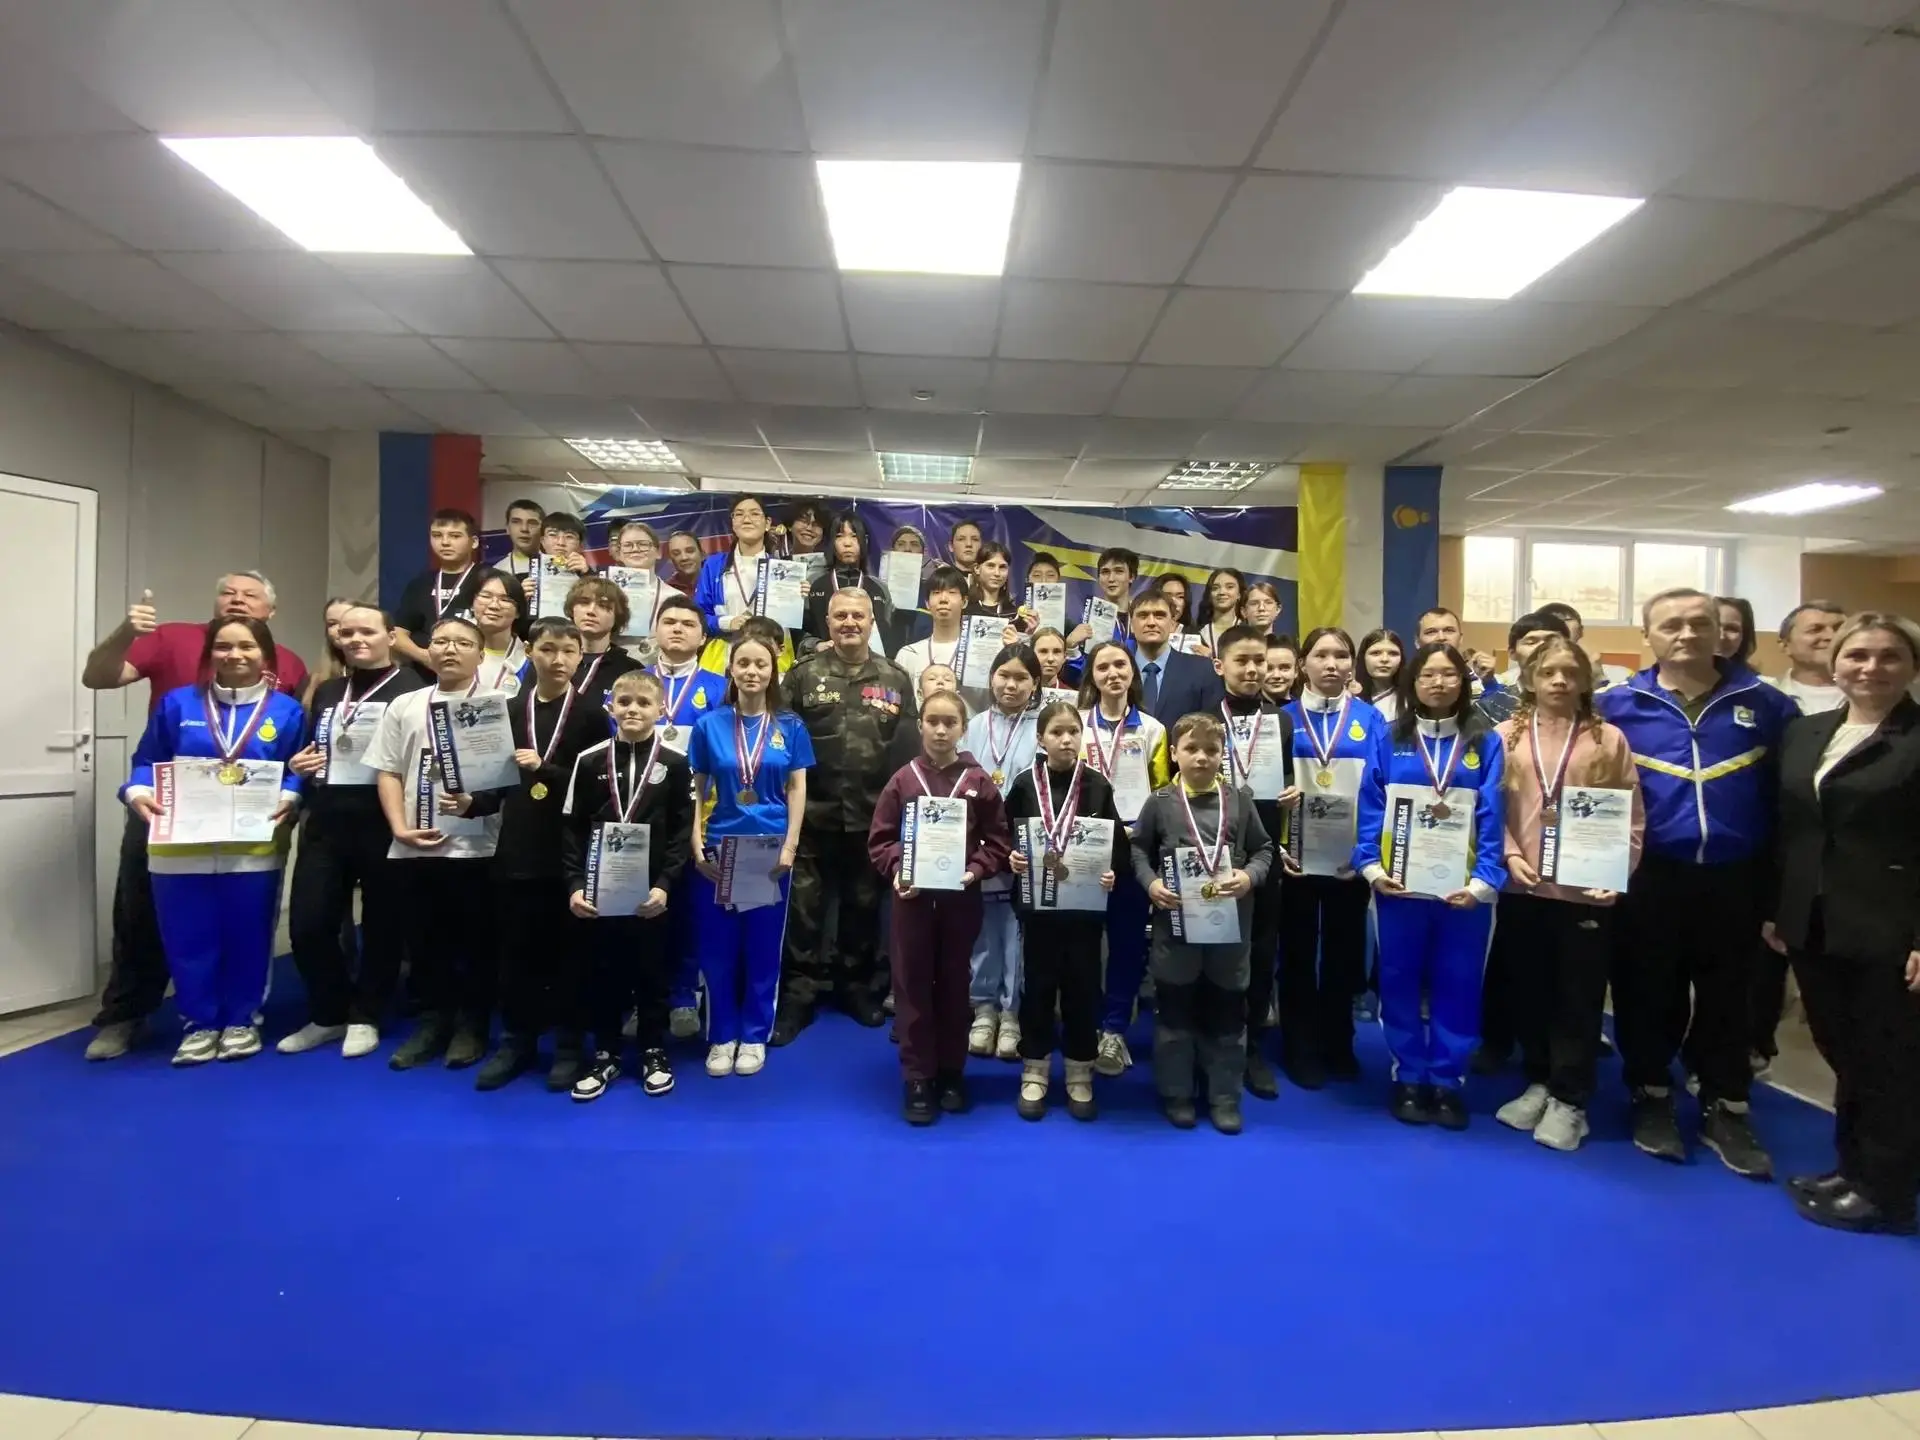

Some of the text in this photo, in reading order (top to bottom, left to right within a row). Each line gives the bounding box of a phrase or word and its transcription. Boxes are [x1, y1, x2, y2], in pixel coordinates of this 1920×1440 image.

[755, 562, 767, 616] УЛЕВАЯ СТРЕЛЬБА
[959, 620, 969, 652] СТРЕЛЬБА
[319, 707, 334, 743] СТРЕЛЬБА
[434, 707, 459, 789] ПУЛЕВАЯ СТРЕЛЬБА
[161, 766, 174, 806] СТРЕЛЬБА
[902, 801, 916, 880] ПУЛЕВАЯ СТРЕЛЬБА
[1395, 804, 1409, 844] СТРЕЛЬБА
[588, 828, 601, 871] СТРЕЛЬБА
[1541, 837, 1556, 877] ПУЛЕВАЯ
[1170, 910, 1182, 937] ПУЛЕВ
